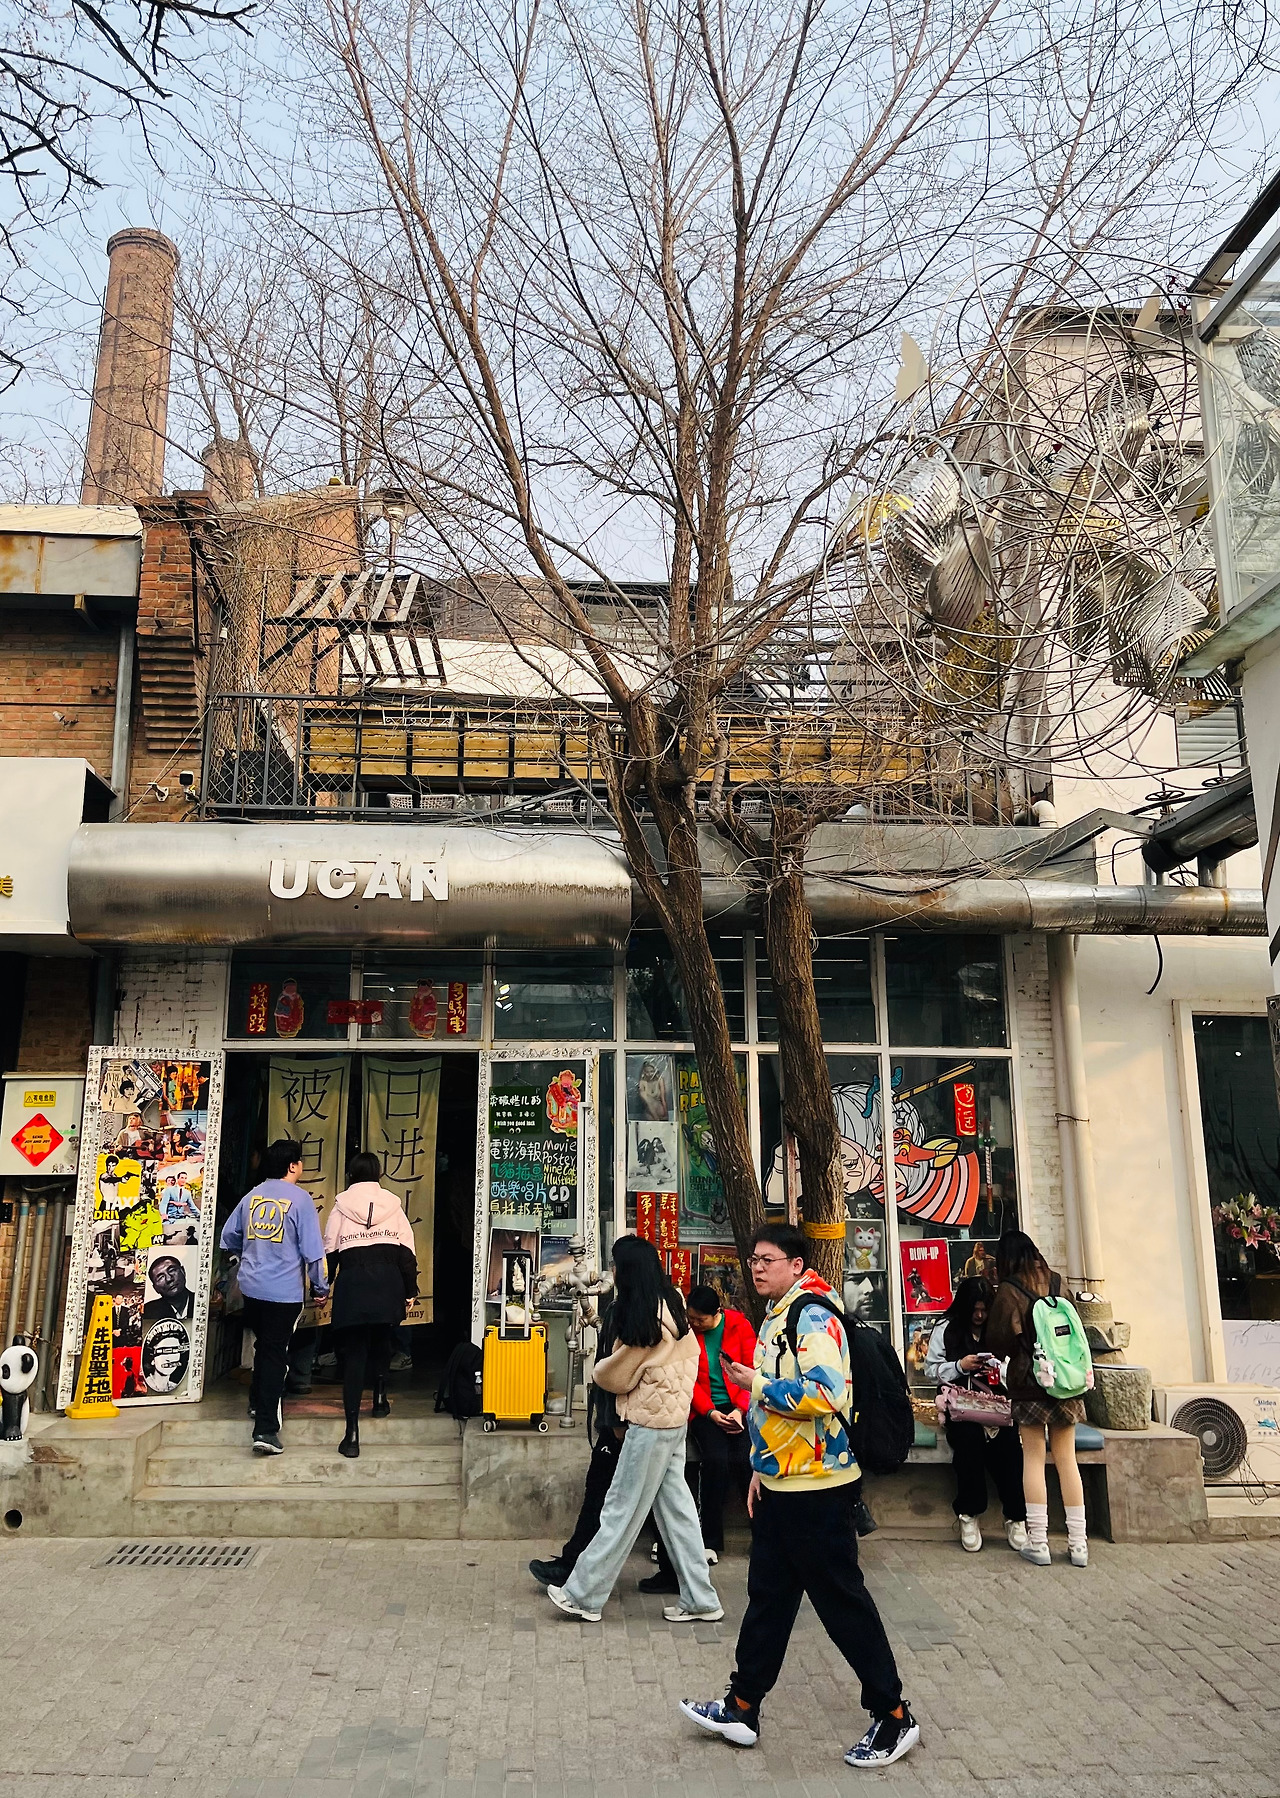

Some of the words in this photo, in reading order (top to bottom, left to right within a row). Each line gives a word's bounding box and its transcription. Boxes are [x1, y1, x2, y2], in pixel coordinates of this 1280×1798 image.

[269, 859, 449, 902] UCAN
[490, 1138, 543, 1163] 電影海報
[543, 1139, 577, 1152] Movie
[543, 1163, 563, 1175] Nine
[548, 1186, 571, 1202] CD
[909, 1247, 939, 1261] BLOW-UP
[84, 1326, 112, 1395] 生財聖地
